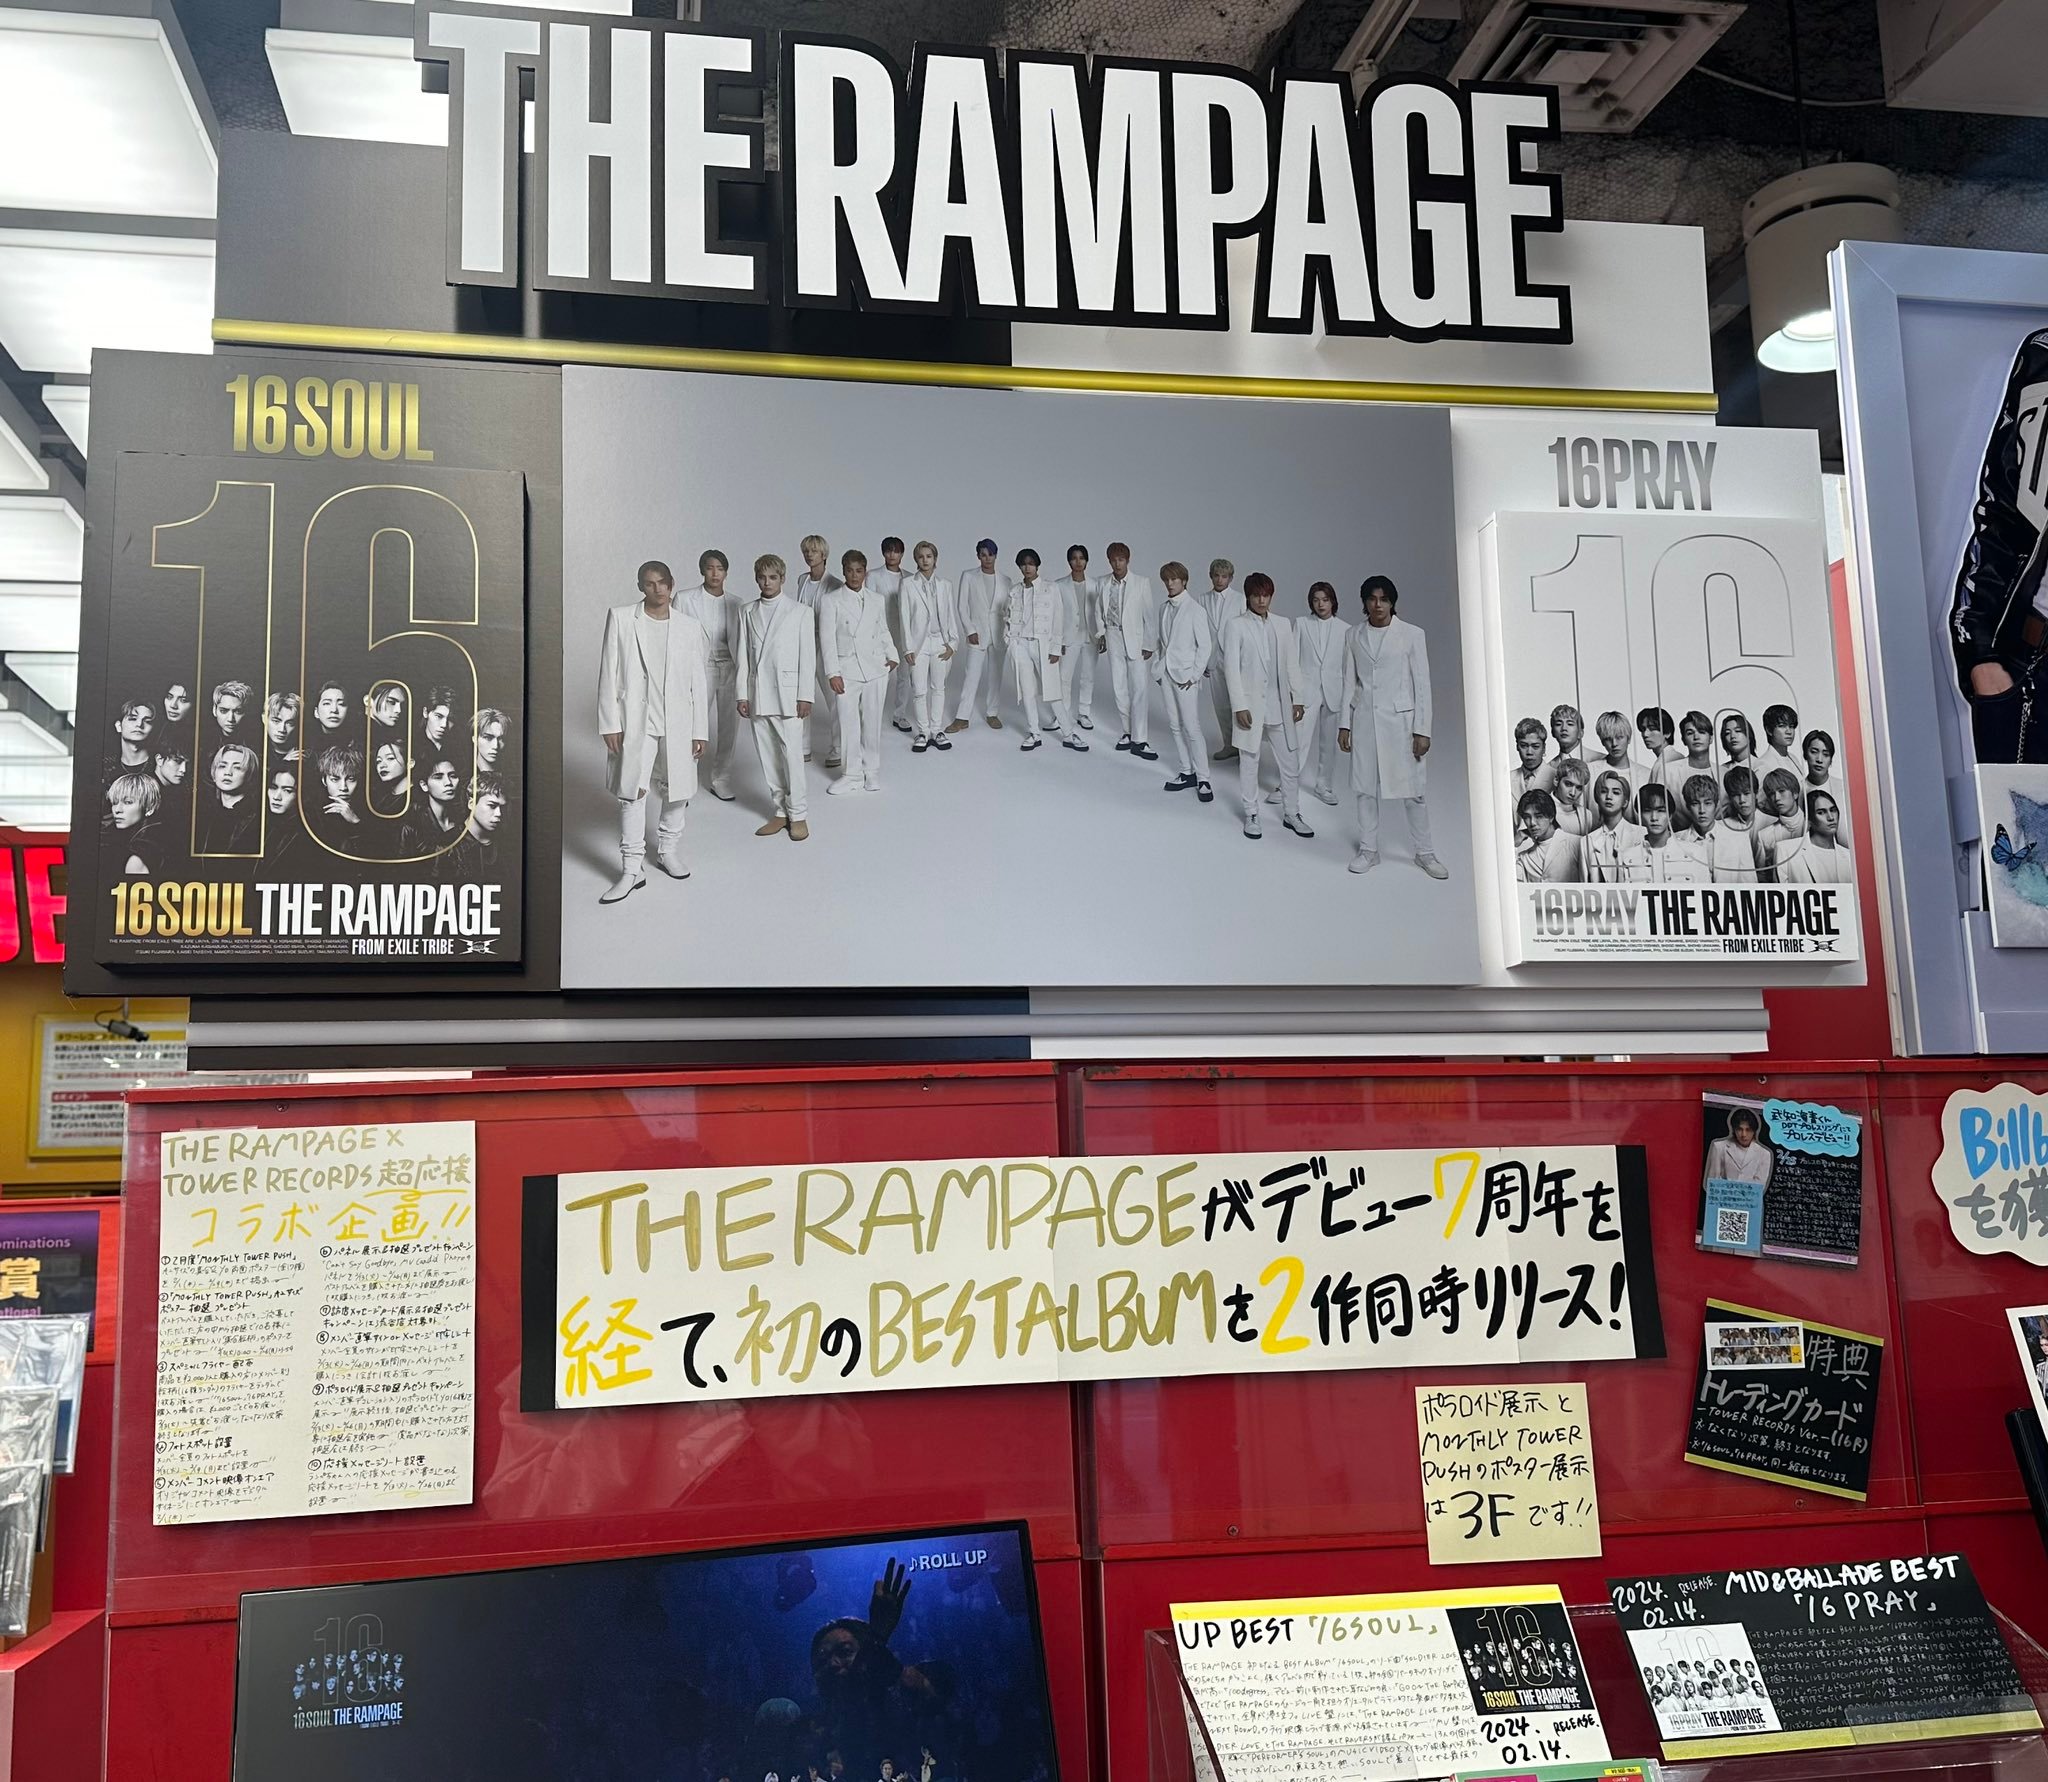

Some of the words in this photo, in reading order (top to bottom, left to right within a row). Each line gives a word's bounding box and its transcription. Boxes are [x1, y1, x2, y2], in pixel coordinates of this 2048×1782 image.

[426, 12, 756, 291] THE
[793, 43, 1564, 330] RAMPAGE
[225, 374, 434, 461] 16SOUL
[1548, 436, 1718, 511] 16PRAY
[150, 480, 480, 863] 16
[1530, 534, 1808, 871] 16
[110, 881, 253, 936] 16SOUL
[255, 883, 323, 936] THE
[330, 884, 502, 936] RAMPAGE
[1529, 888, 1640, 937] 16PRAY
[1642, 889, 1698, 936] THE
[1703, 889, 1840, 936] RAMPAGE
[352, 938, 386, 956] FROM
[387, 939, 419, 955] EXILE
[421, 938, 455, 955] TRIBE
[1722, 938, 1749, 954] FROM
[1751, 939, 1777, 954] EXILE
[1778, 939, 1805, 954] TRIBE
[163, 1136, 220, 1169] THE
[229, 1127, 378, 1163] RAMPAGE
[163, 1169, 258, 1197] TOWER
[266, 1162, 372, 1193] RECORDS
[564, 1177, 777, 1276] THE
[0, 1237, 72, 1250] minations
[244, 1252, 270, 1261] TOWER
[214, 1291, 243, 1301] TOWER
[1806, 1334, 1870, 1391] 特典
[1751, 1414, 1796, 1435] RECORDS
[1421, 1428, 1509, 1457] MONTHLY
[1517, 1424, 1583, 1452] TOWER
[920, 1552, 962, 1570] ROLL
[964, 1549, 988, 1565] UP
[1889, 1554, 1960, 1583] BEST
[1177, 1619, 1221, 1650] UP
[1231, 1617, 1293, 1649] BEST
[1763, 1627, 1804, 1638] RAMPAGE
[1183, 1662, 1198, 1671] THE
[1201, 1661, 1243, 1671] RAMPAGE
[1284, 1659, 1301, 1670] BEST
[1223, 1700, 1236, 1710] THE
[1516, 1689, 1538, 1706] THE
[1535, 1687, 1581, 1705] RAMPAGE
[292, 1709, 333, 1729] 16SOUL
[333, 1707, 353, 1726] THE
[354, 1701, 403, 1724] RAMPAGE
[1380, 1708, 1415, 1718] RAMPAGE
[1419, 1707, 1438, 1716] LIVE
[1701, 1709, 1723, 1728] THE
[1721, 1707, 1767, 1726] RAMPAGE
